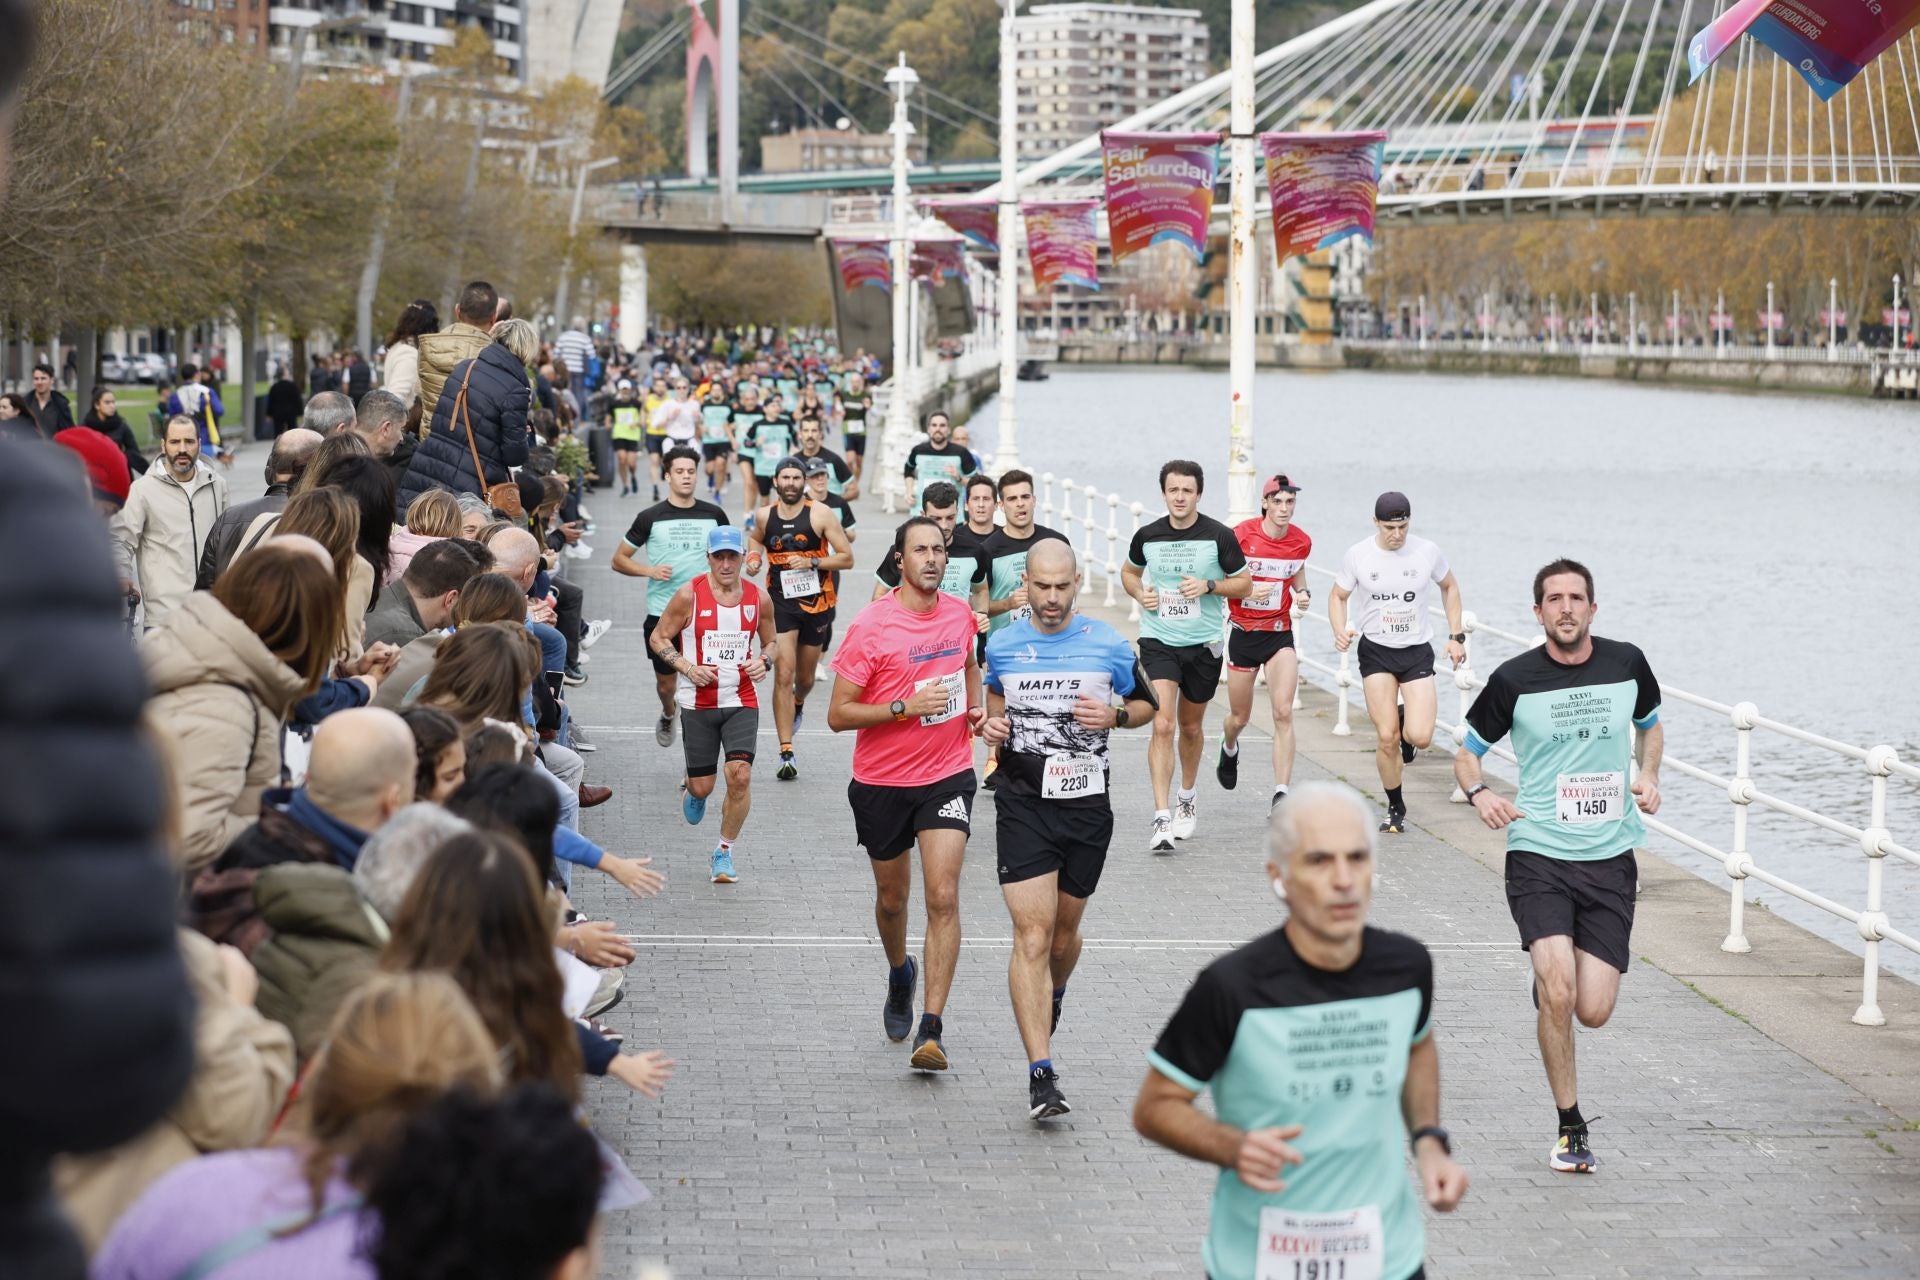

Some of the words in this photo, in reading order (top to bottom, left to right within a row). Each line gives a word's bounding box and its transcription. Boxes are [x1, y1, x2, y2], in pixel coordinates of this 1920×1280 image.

[1107, 145, 1149, 167] Fair
[1108, 161, 1213, 190] Saturday
[792, 582, 811, 592] 1633
[1371, 593, 1400, 601] bbk
[1168, 605, 1189, 616] 2543
[1390, 623, 1410, 633] 1955
[718, 649, 735, 661] 423
[1018, 679, 1082, 690] MARY'S
[1569, 692, 1592, 701] XXXVI
[1551, 710, 1573, 719] CARRERA
[1574, 707, 1612, 716] INTERNACIONAL
[1061, 774, 1088, 792] 2230
[1048, 787, 1054, 797] k
[1562, 787, 1590, 798] XXXVI
[1592, 790, 1619, 798] BILBAO
[1576, 799, 1607, 815] 1450
[938, 808, 969, 824] adida
[1562, 811, 1569, 822] k
[1295, 1259, 1345, 1280] 1911
